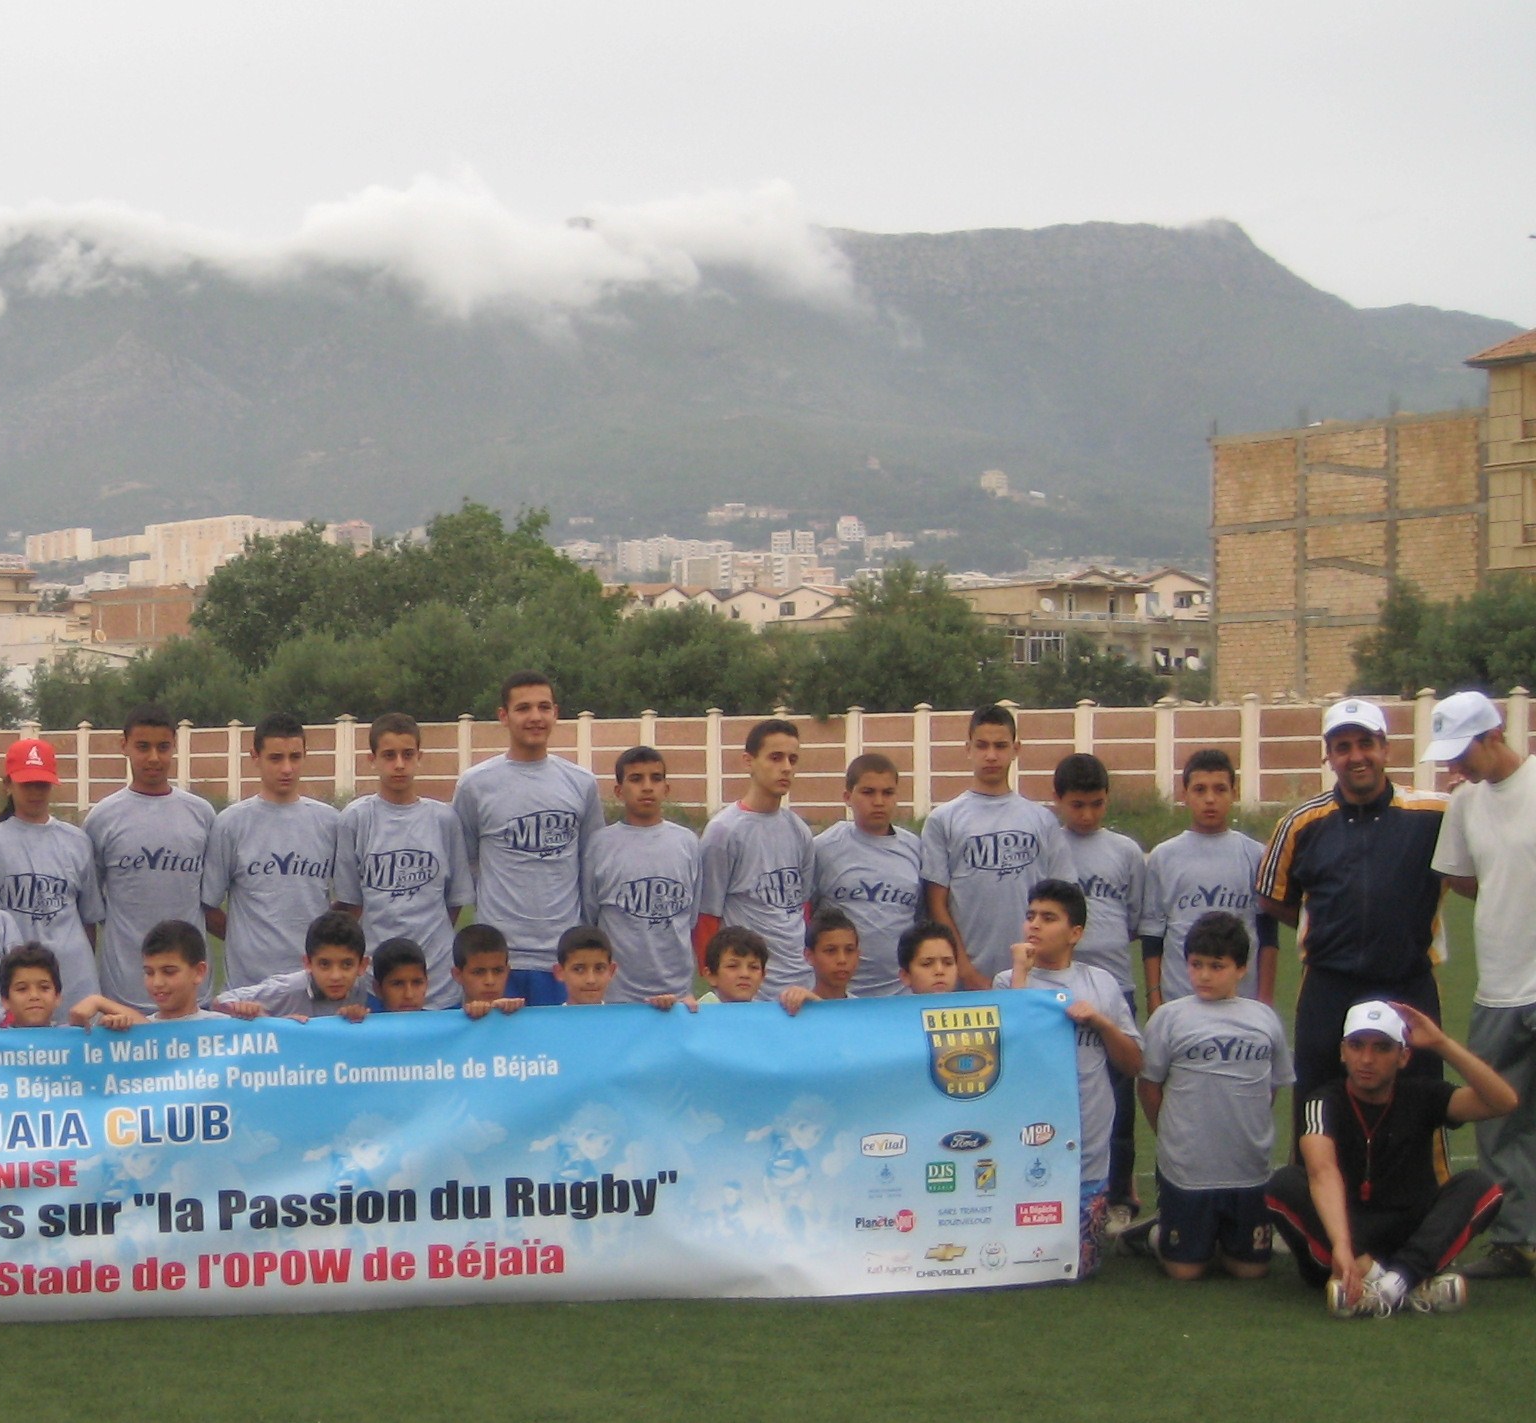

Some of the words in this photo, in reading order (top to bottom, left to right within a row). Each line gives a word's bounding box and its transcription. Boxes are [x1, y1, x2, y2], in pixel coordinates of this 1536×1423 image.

[118, 846, 202, 873] ceVital
[965, 831, 1035, 868] Mon
[247, 851, 331, 879] ceVital
[364, 851, 432, 888] Mon
[4, 874, 68, 910] Mon
[620, 877, 686, 914] Mon
[835, 880, 916, 907] ceVita
[1178, 884, 1251, 911] ceVita
[927, 1011, 995, 1028] BÉJAIA
[83, 1043, 103, 1064] le
[109, 1039, 159, 1063] Wali
[165, 1037, 191, 1060] de
[197, 1032, 280, 1057] BEJAIA
[932, 1031, 996, 1048] RUGBY
[1187, 1036, 1272, 1062] ceVita
[16, 1074, 84, 1101] Béjaïa
[104, 1068, 219, 1096] Assemblée
[226, 1063, 328, 1092] Populaire
[333, 1058, 456, 1085] Communale
[461, 1057, 487, 1080] de
[492, 1053, 560, 1082] Béjaïa
[947, 1081, 985, 1094] CLUB
[105, 1102, 233, 1147] CLUB
[1022, 1123, 1052, 1146] Mon
[864, 1138, 904, 1151] ceVital
[950, 1134, 980, 1149] Ford
[928, 1164, 954, 1178] DJS
[38, 1200, 122, 1238] sur
[133, 1193, 206, 1233] "la
[217, 1184, 418, 1231] Passion
[429, 1180, 493, 1221] du
[504, 1170, 680, 1220] Rugby"
[131, 1256, 187, 1292] de
[198, 1248, 352, 1289] l'OPOW
[362, 1246, 416, 1283] de
[428, 1239, 565, 1281] Béjaïa
[916, 1266, 977, 1279] CHEVROLET
